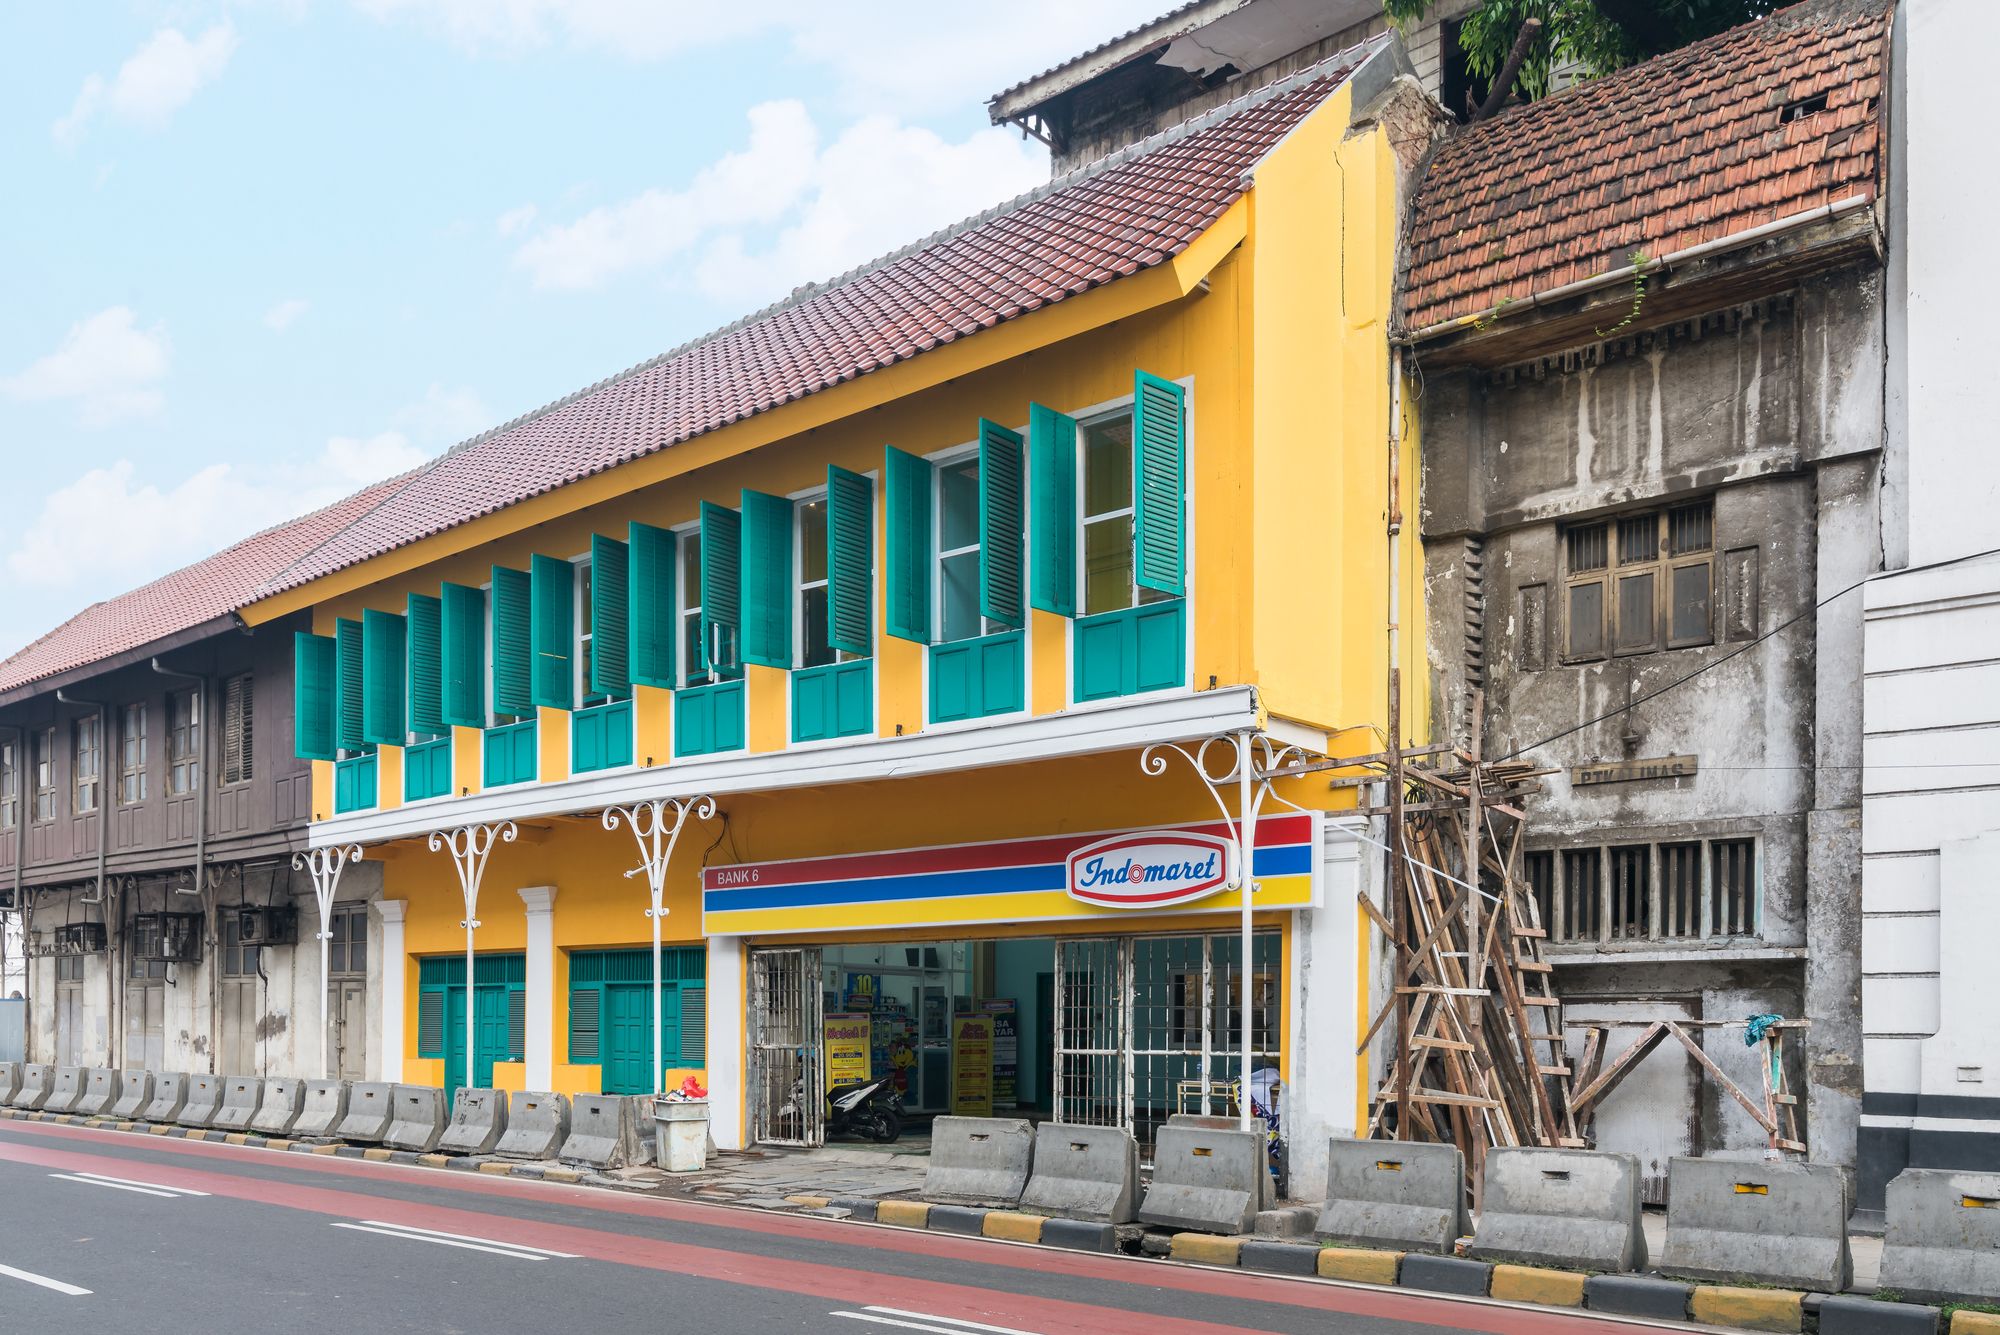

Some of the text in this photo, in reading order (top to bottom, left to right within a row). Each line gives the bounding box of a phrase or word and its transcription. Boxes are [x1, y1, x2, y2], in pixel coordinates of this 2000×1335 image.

[717, 869, 759, 885] BANK 6
[1080, 852, 1216, 887] Indomaret
[857, 974, 872, 993] 10
